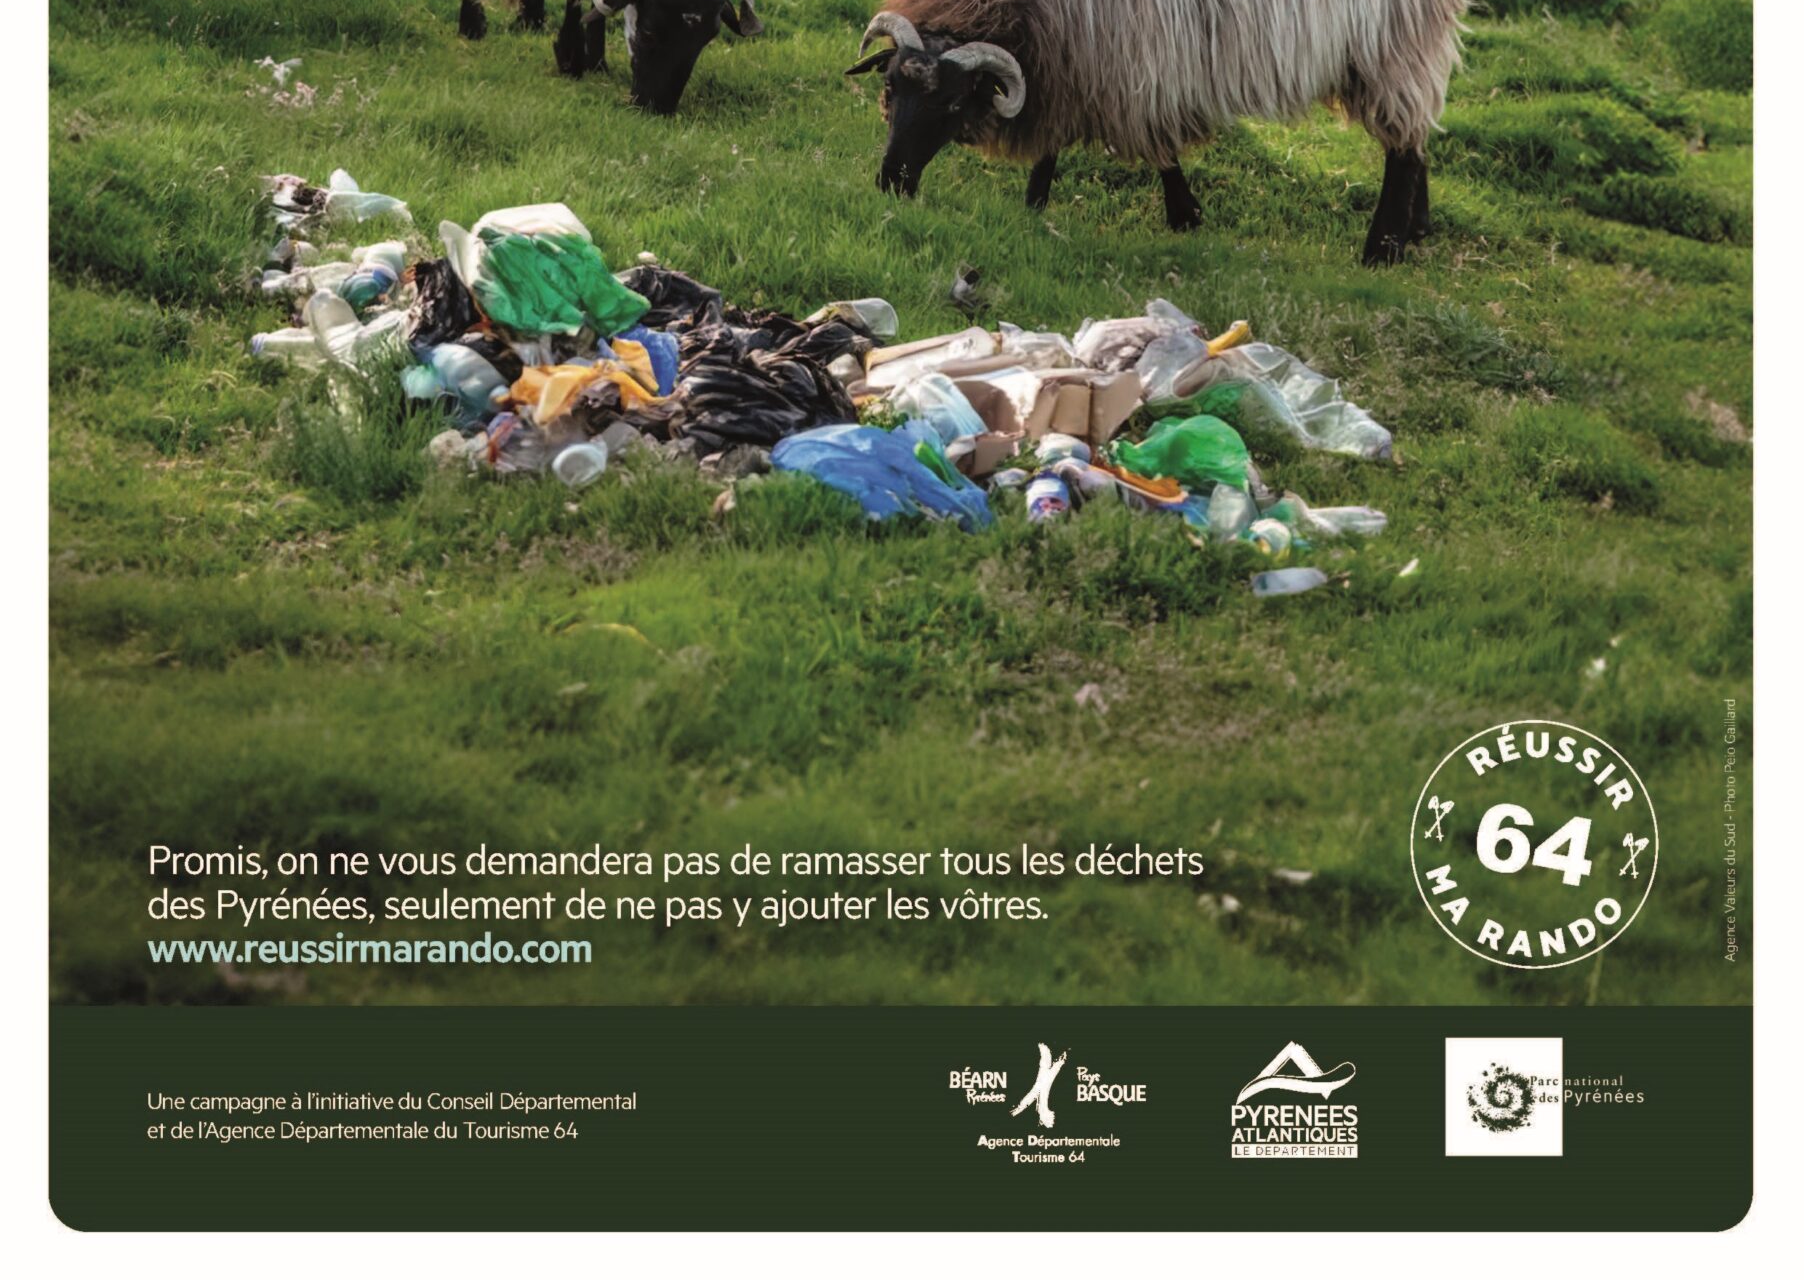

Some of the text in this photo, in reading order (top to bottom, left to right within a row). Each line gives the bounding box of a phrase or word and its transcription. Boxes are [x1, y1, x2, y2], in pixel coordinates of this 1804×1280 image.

[1725, 699, 1736, 743] Gaillard
[1466, 725, 1634, 810] RÉUSSIR
[1725, 746, 1736, 773] Peio
[1725, 776, 1736, 812] Photo
[1477, 804, 1592, 886] 64
[1725, 823, 1736, 846] Sud
[151, 844, 1203, 882] Promis, on ne vous demandera pas de ramasser tous les déchets
[1725, 849, 1736, 864] du
[1725, 867, 1736, 912] Valeurs
[148, 888, 1048, 927] des Pyrénées, seulement de ne pas y ajouter les vôtres.
[1426, 864, 1621, 958] MA RANDO
[148, 932, 591, 963] www.reussirmarando.com
[1724, 914, 1737, 962] Agence
[949, 1067, 1007, 1088] BÉARN
[1077, 1067, 1100, 1085] Pays
[1530, 1076, 1623, 1086] Parc national
[148, 1093, 636, 1115] Une campagne à l'initiative du Conseil Départemental
[967, 1089, 1006, 1105] Pyrénées
[1077, 1085, 1146, 1105] BASQUE
[1539, 1089, 1644, 1106] des Pyrénées
[1231, 1106, 1358, 1126] PYRENEES
[148, 1122, 578, 1142] et de l'Agence Départementale du Tourisme 64
[978, 1134, 1120, 1149] Agence Départementale
[1232, 1128, 1358, 1143] ATLANTIQUES
[1012, 1151, 1085, 1163] Tourisme 64
[1235, 1146, 1355, 1155] LE DEPARTEMENT
